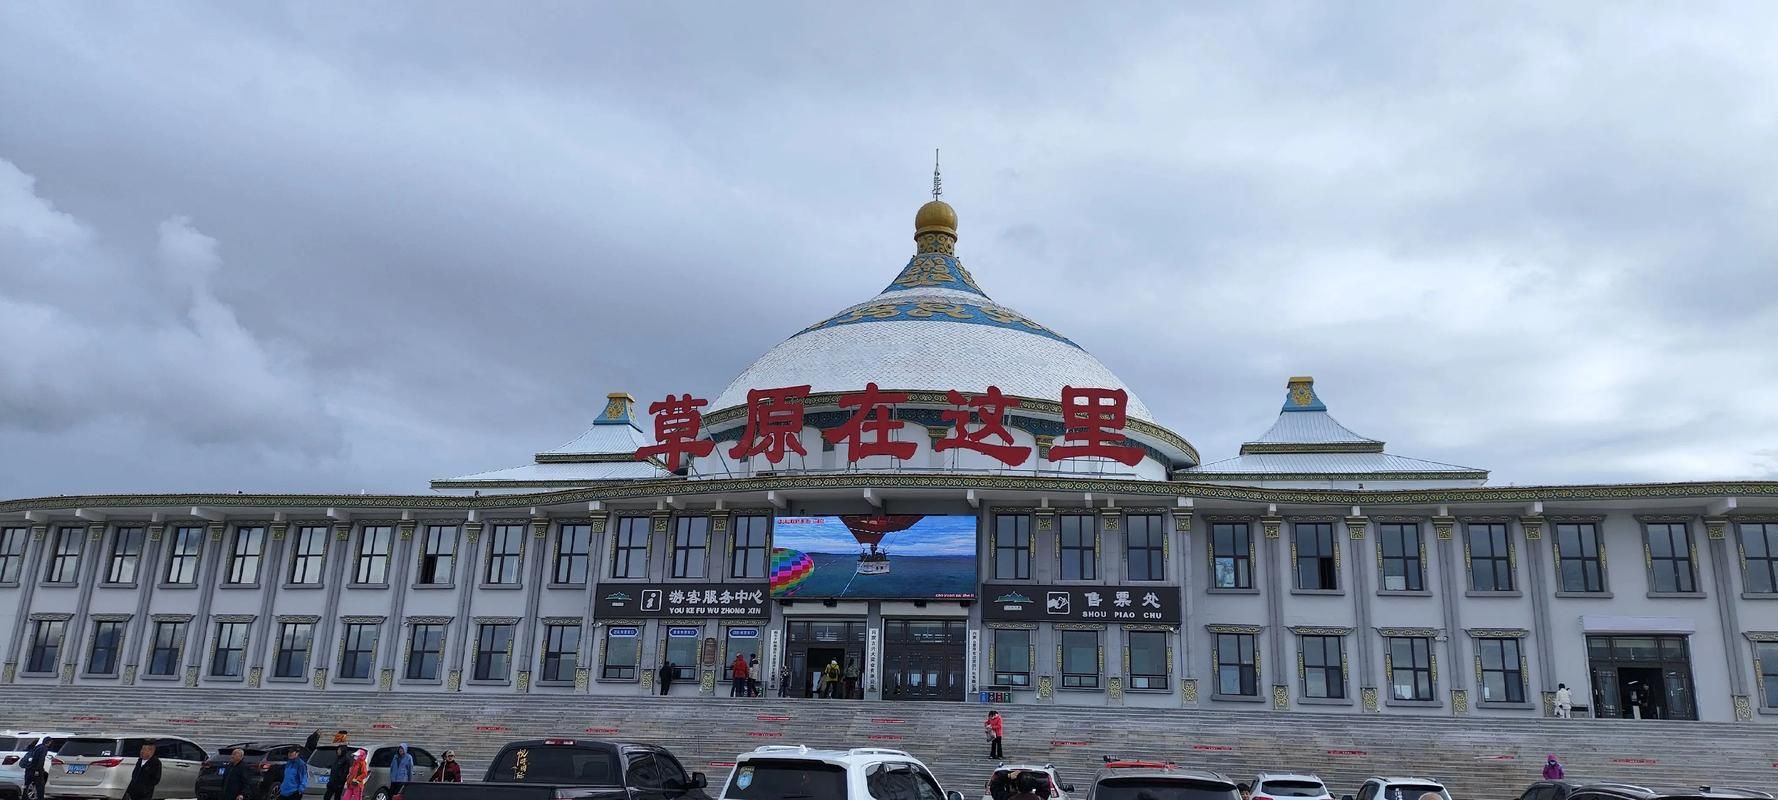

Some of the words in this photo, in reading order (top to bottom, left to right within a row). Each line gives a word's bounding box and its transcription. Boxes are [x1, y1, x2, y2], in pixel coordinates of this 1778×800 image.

[634, 382, 1146, 472] 草原在这里
[668, 589, 763, 604] 游客服务中心
[1084, 591, 1161, 609] 售票处
